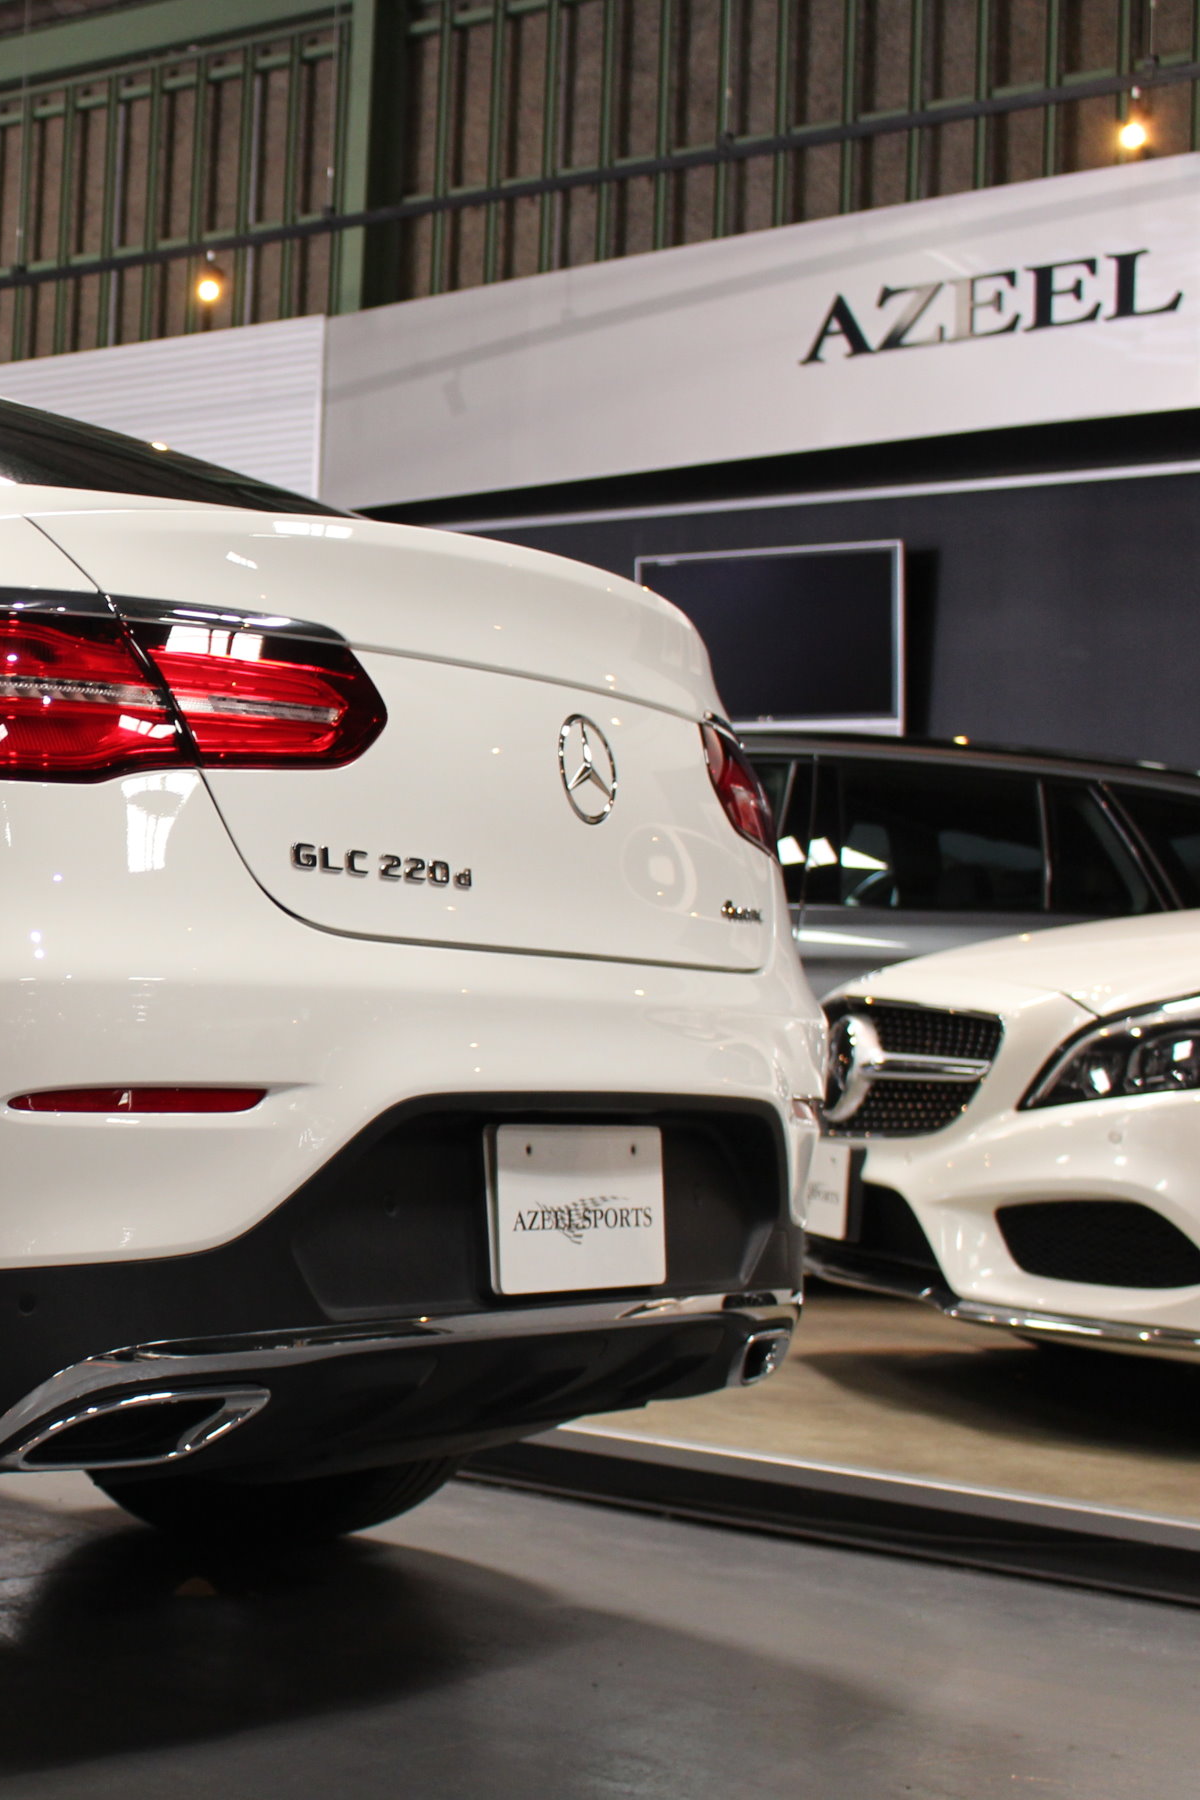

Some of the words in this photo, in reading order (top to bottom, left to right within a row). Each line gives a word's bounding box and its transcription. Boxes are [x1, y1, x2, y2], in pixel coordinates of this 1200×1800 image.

[798, 248, 1183, 366] AZEEL
[291, 842, 369, 877] GLC
[581, 1206, 653, 1230] SPORTS
